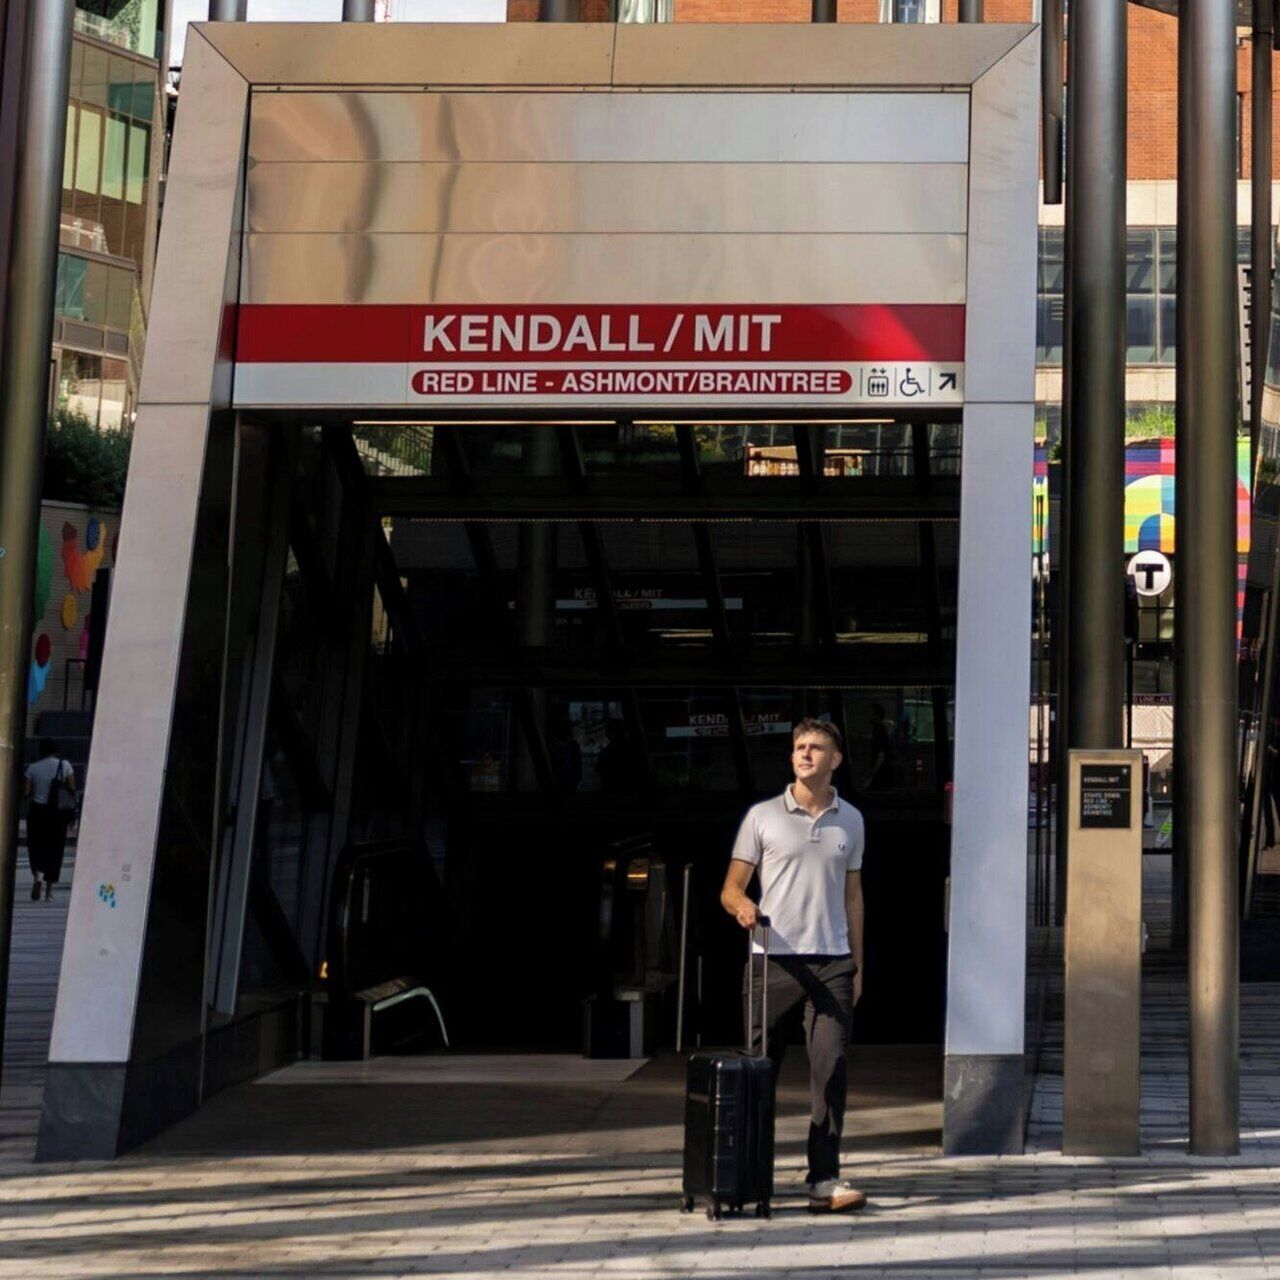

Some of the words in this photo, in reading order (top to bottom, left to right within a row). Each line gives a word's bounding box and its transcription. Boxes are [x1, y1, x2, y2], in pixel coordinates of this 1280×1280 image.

[423, 314, 655, 352] KENDALL
[693, 314, 782, 352] MIT
[422, 372, 474, 392] RED
[482, 372, 537, 392] LINE
[561, 372, 842, 392] ASHMONT/BRAINTREE
[1135, 563, 1164, 590] T
